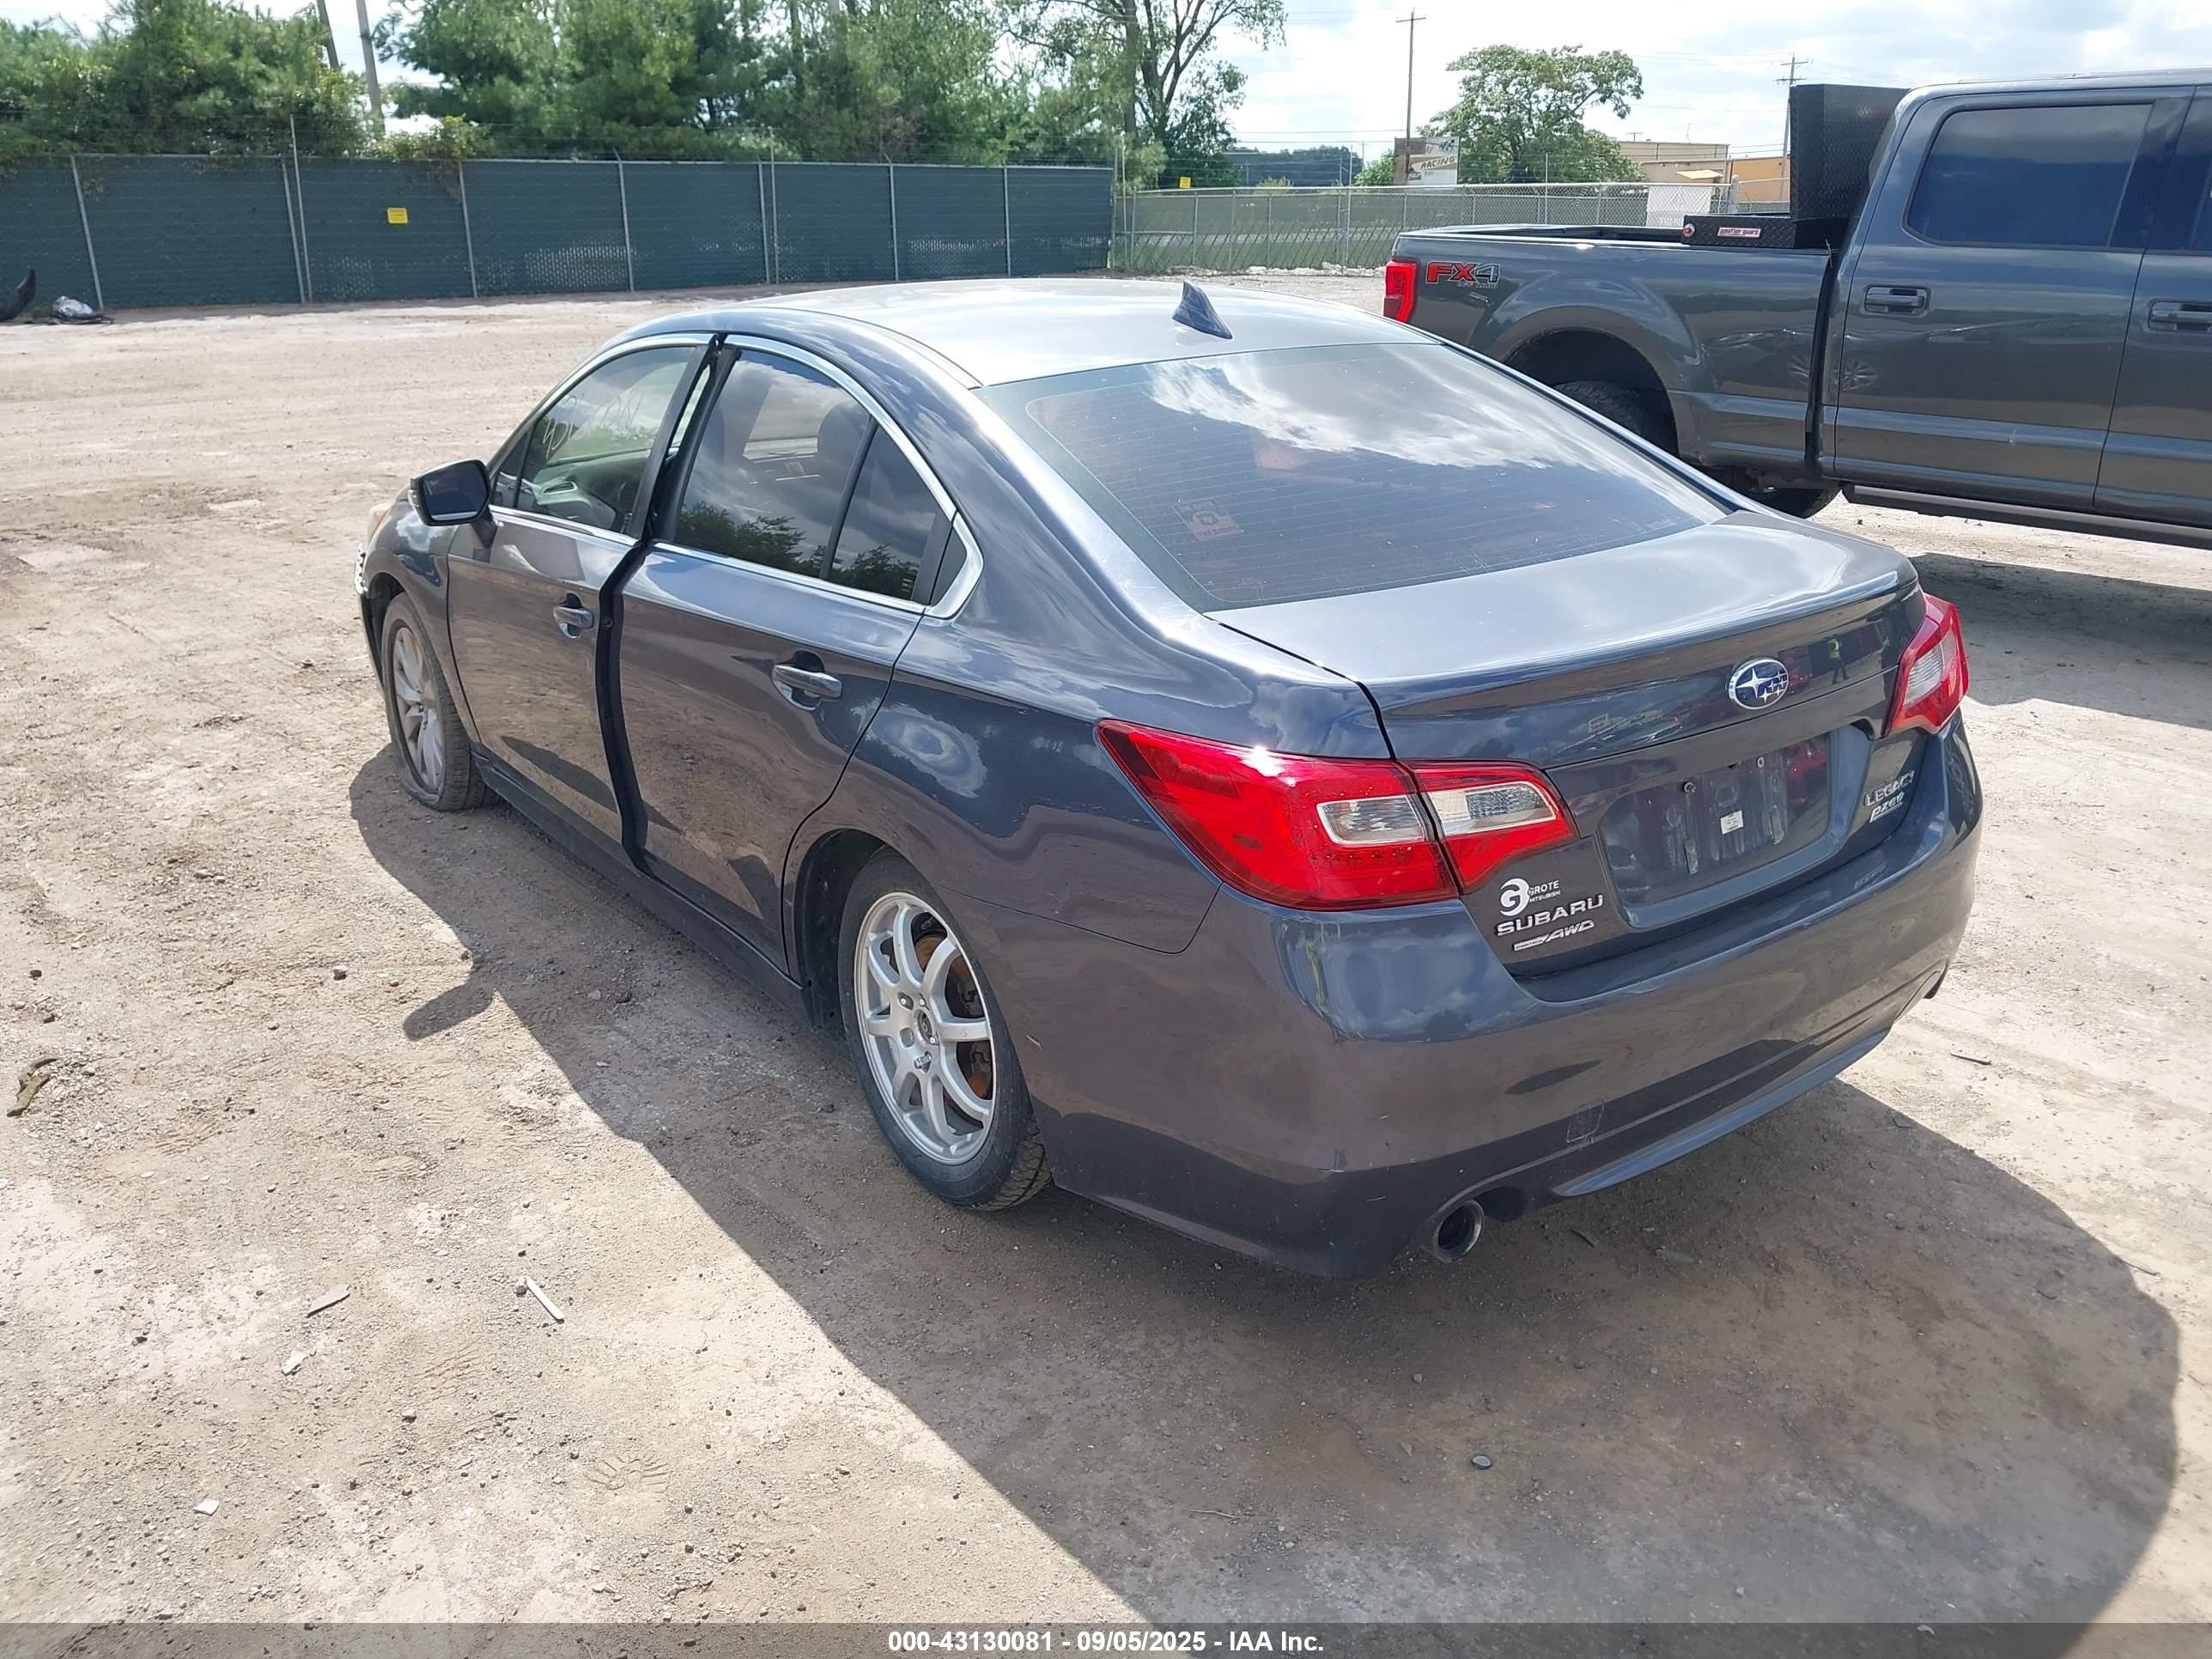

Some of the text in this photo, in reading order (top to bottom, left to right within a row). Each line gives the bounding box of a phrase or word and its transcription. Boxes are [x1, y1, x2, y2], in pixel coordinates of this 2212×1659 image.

[1420, 156, 1455, 170] RACING
[1425, 260, 1501, 284] FX4
[1528, 879, 1559, 896] GROTE
[1528, 890, 1561, 902] MITSUBISHI
[1497, 894, 1604, 937] SUBARU
[1546, 920, 1595, 943] AWD
